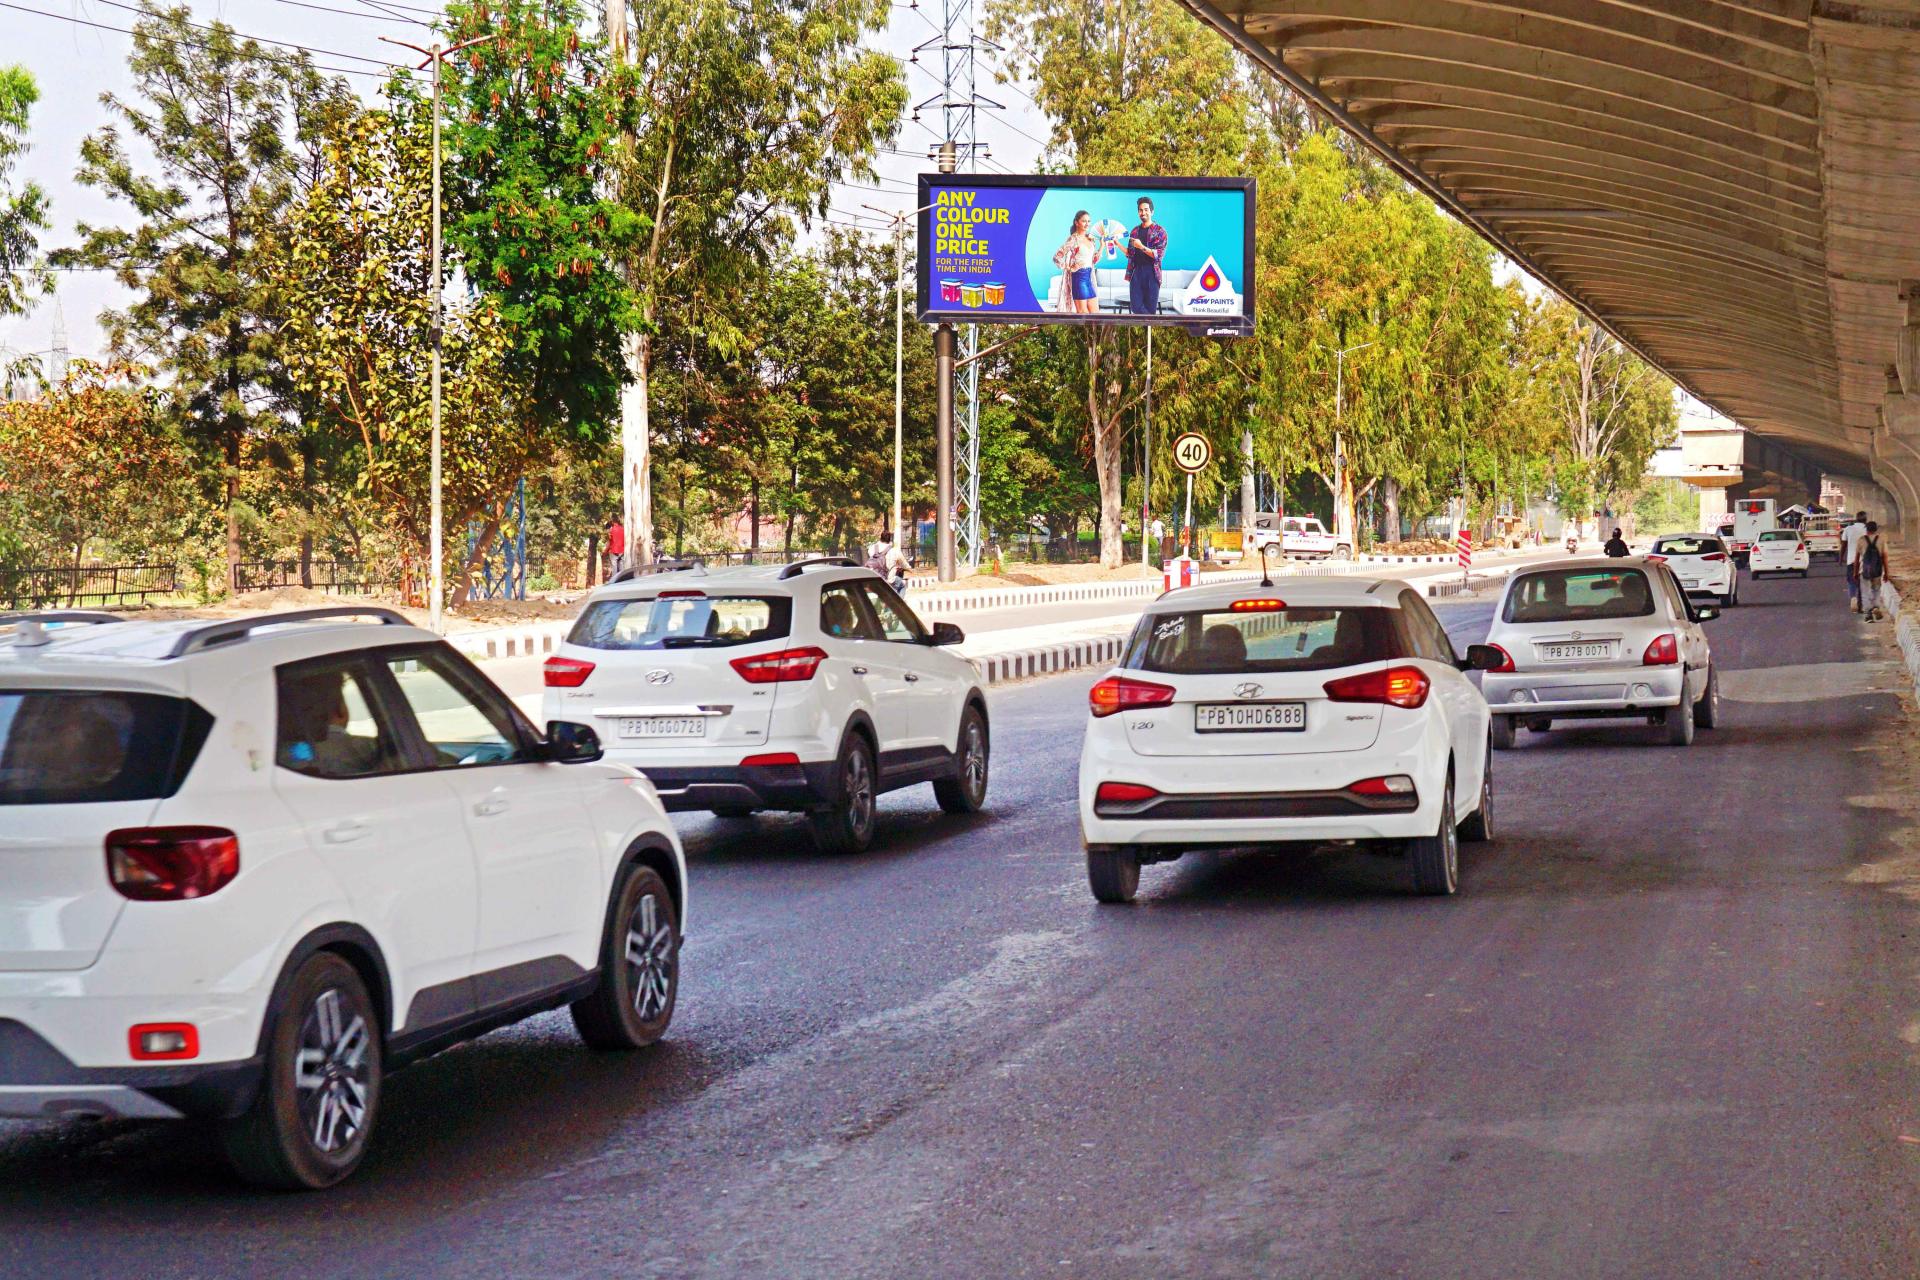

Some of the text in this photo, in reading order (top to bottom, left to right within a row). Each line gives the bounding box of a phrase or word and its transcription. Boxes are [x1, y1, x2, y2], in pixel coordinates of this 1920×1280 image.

[937, 191, 976, 206] ANY
[936, 207, 1010, 224] COLOUR
[936, 223, 974, 238] ONE
[936, 239, 989, 255] PRICE
[1187, 297, 1210, 305] JSW
[1182, 443, 1201, 461] 40
[1551, 647, 1562, 657] PB
[1585, 645, 1608, 656] 0071
[1208, 708, 1301, 725] PB10HD6888
